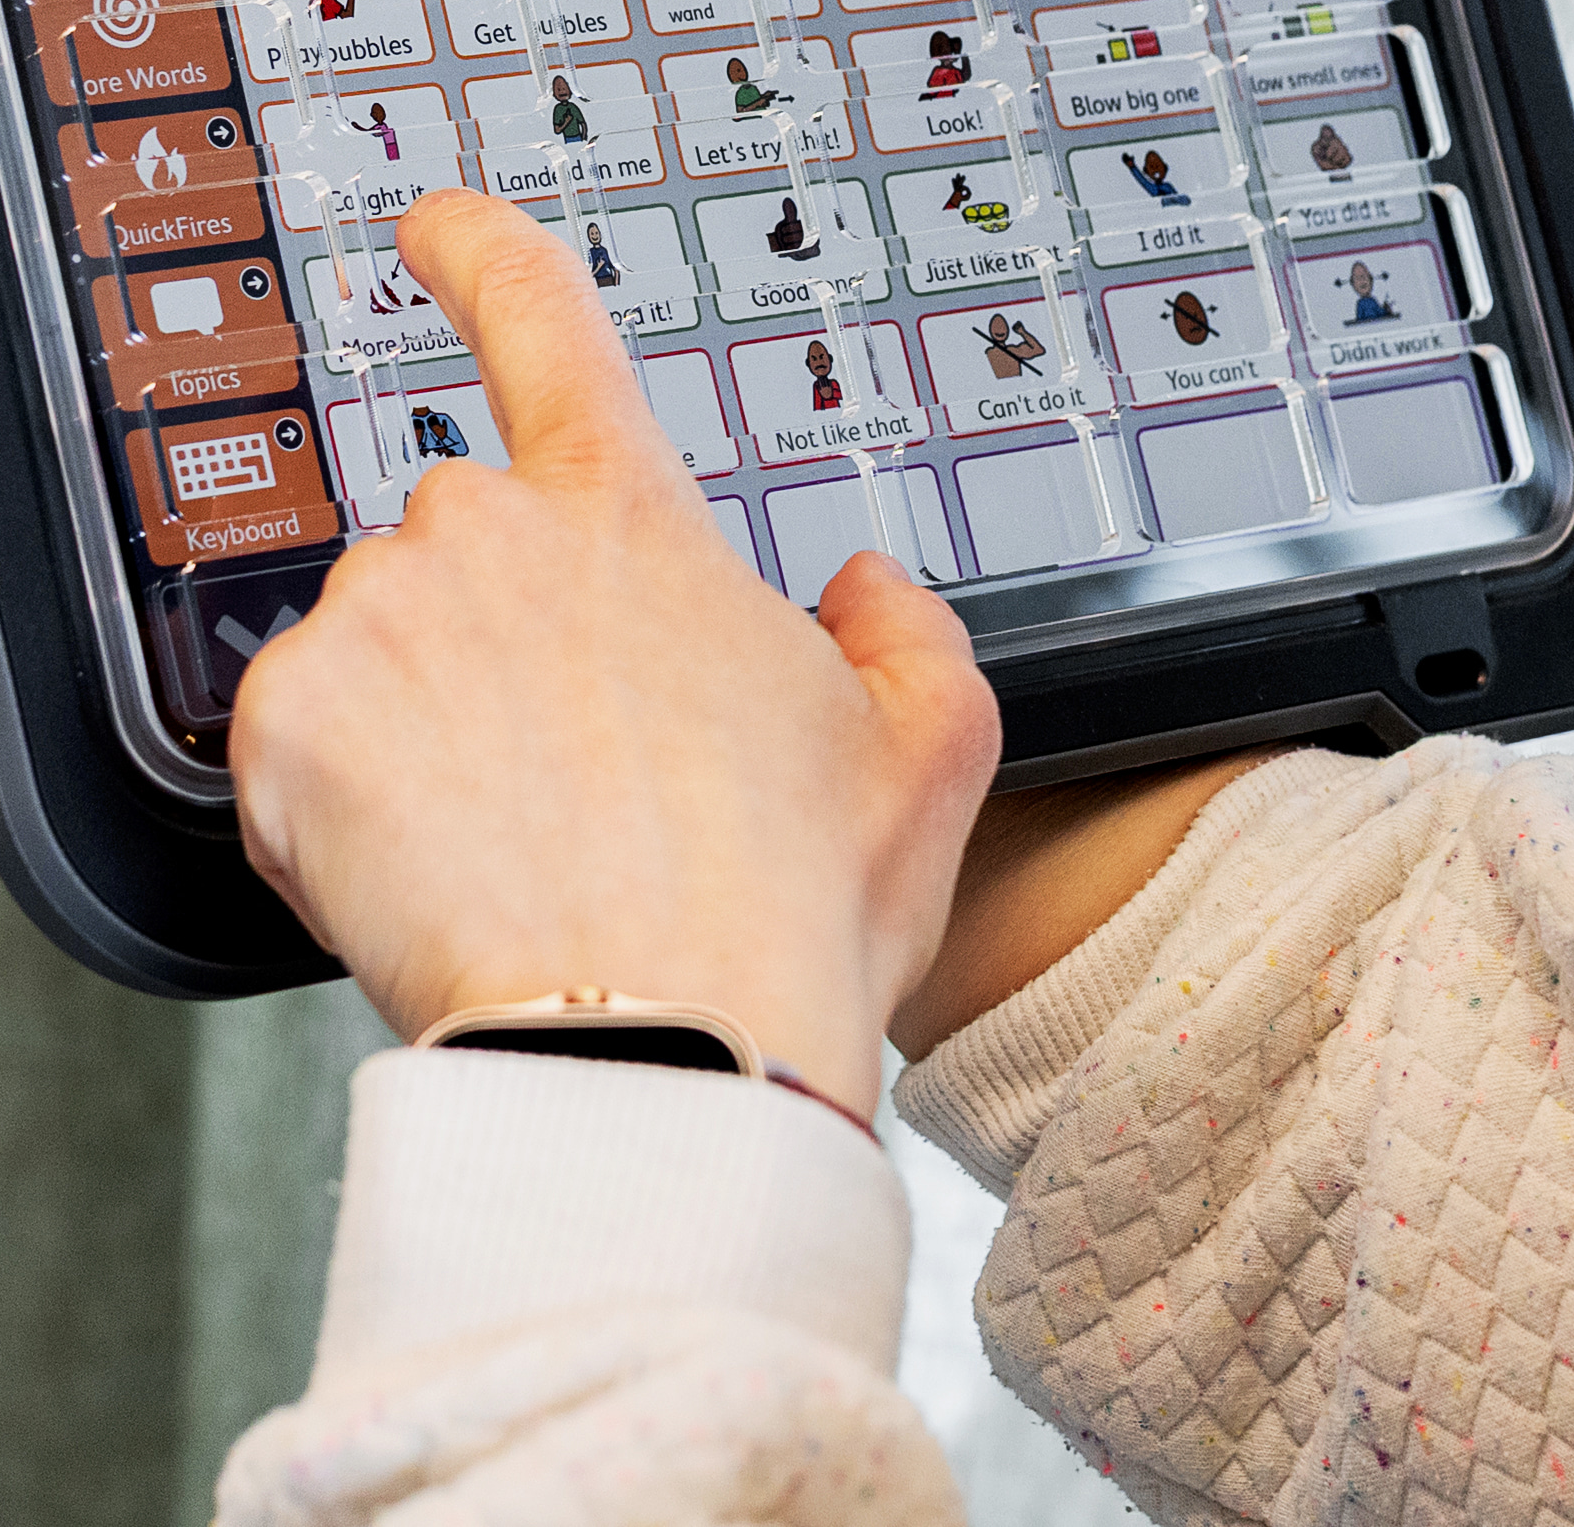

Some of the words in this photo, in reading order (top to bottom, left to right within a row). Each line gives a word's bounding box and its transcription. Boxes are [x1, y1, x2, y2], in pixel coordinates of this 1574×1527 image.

[668, 2, 715, 24] wand
[473, 23, 517, 45] Get
[70, 76, 124, 96] ore
[125, 61, 208, 91] Words
[1249, 75, 1284, 95] low
[1070, 94, 1125, 119] Blow
[1128, 90, 1160, 114] big
[1163, 85, 1200, 105] one
[926, 108, 984, 137] Look!
[617, 158, 653, 177] me
[694, 140, 747, 168] Let's
[751, 141, 781, 163] try
[1297, 208, 1338, 230] You
[1340, 201, 1373, 224] did
[1375, 199, 1390, 219] it
[113, 215, 233, 251] QuickFires
[1137, 230, 1149, 252] I
[1153, 225, 1185, 250] did
[1188, 224, 1205, 245] it
[925, 257, 968, 283] Just
[969, 254, 1008, 277] like
[750, 279, 811, 308] Good
[649, 299, 674, 324] it!
[170, 366, 242, 400] Topics
[1164, 370, 1204, 391] You
[1208, 358, 1260, 382] can't
[977, 395, 1035, 422] Can't
[1037, 391, 1067, 415] do
[1069, 387, 1086, 408] it
[775, 430, 819, 454] Not
[820, 424, 862, 447] like
[864, 413, 914, 439] that
[184, 510, 301, 552] Keyboard
